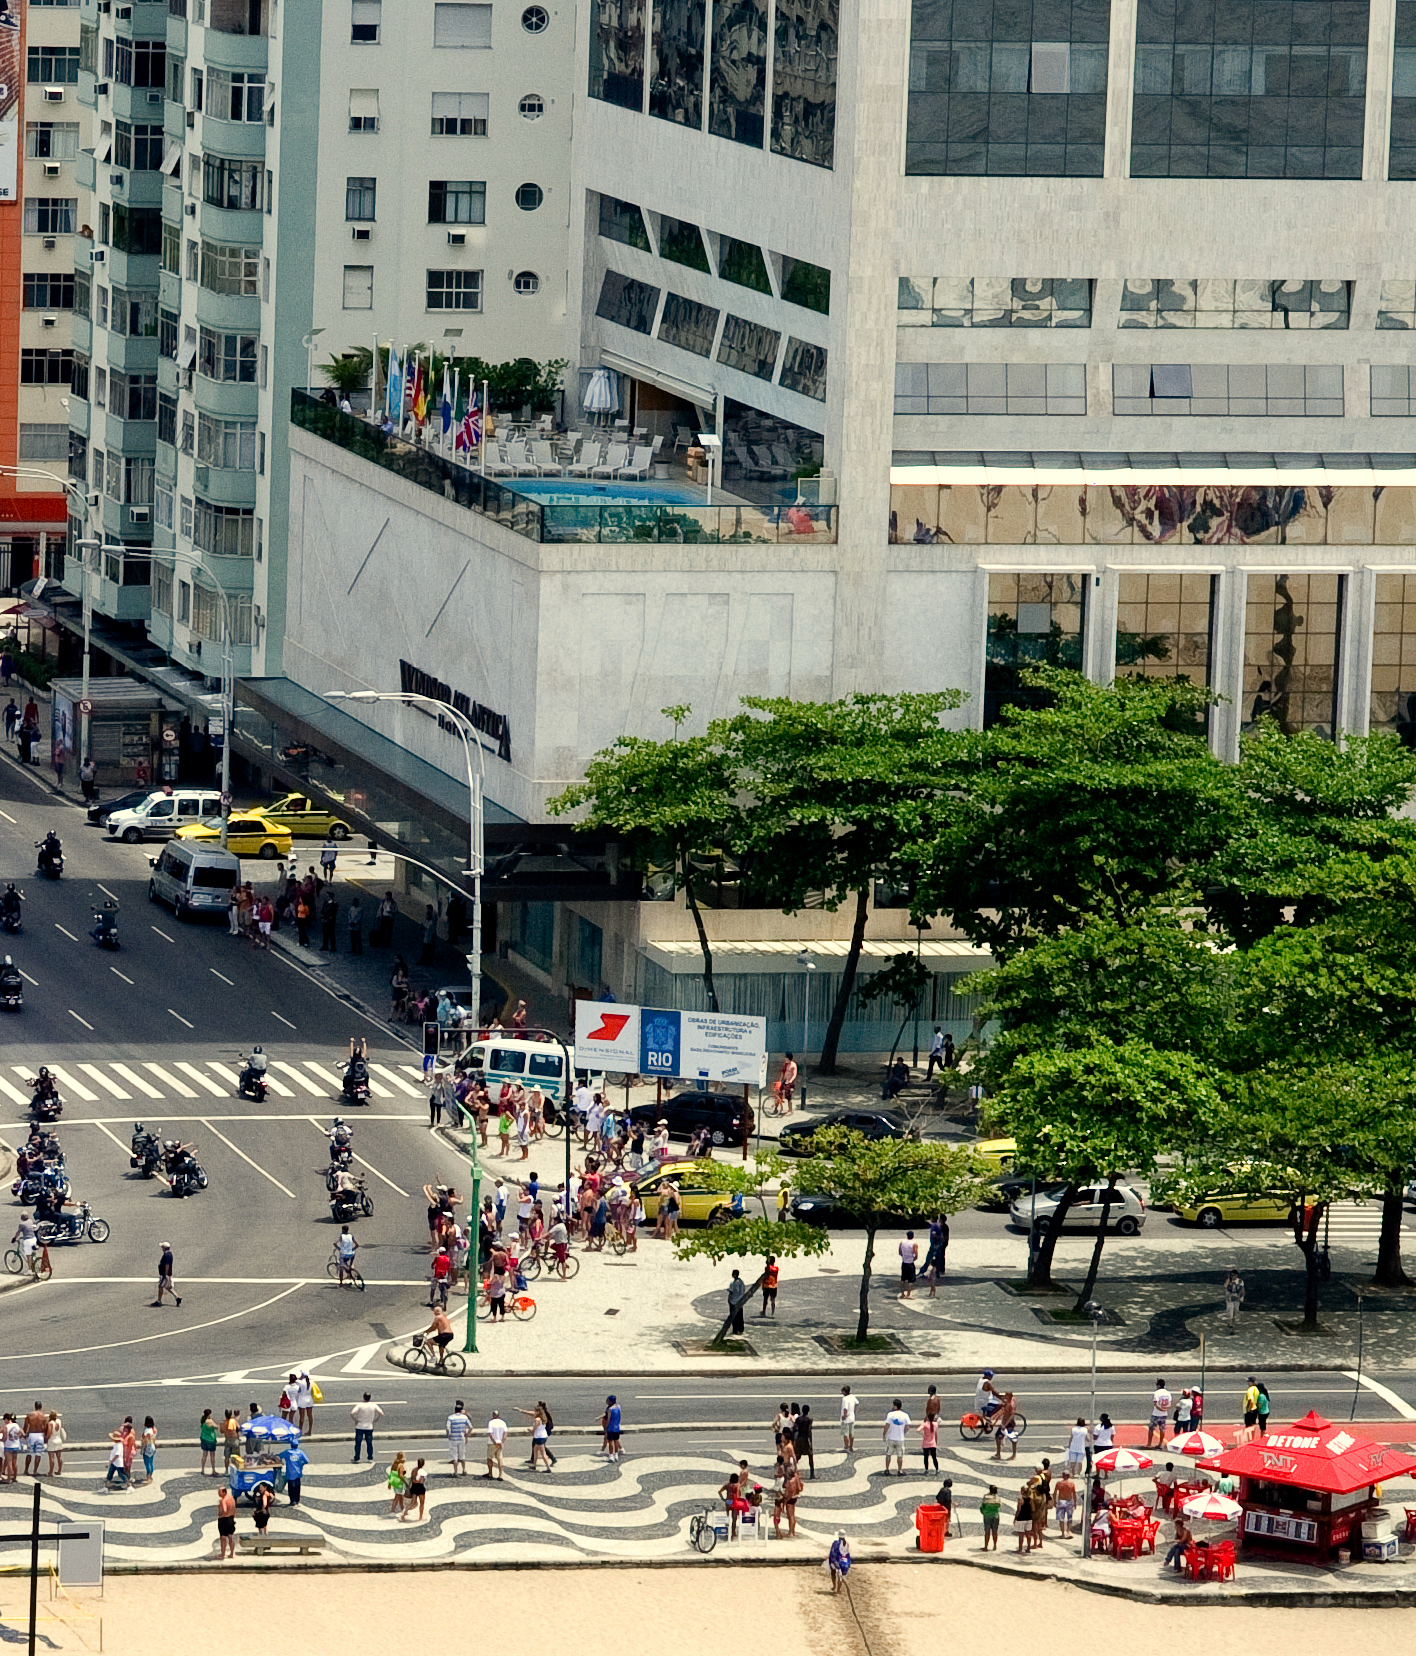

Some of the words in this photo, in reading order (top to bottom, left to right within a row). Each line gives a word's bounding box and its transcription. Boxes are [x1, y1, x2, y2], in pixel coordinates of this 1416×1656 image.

[647, 1051, 672, 1067] RIO
[1266, 1435, 1321, 1449] DETONE
[1258, 1451, 1296, 1468] TNT
